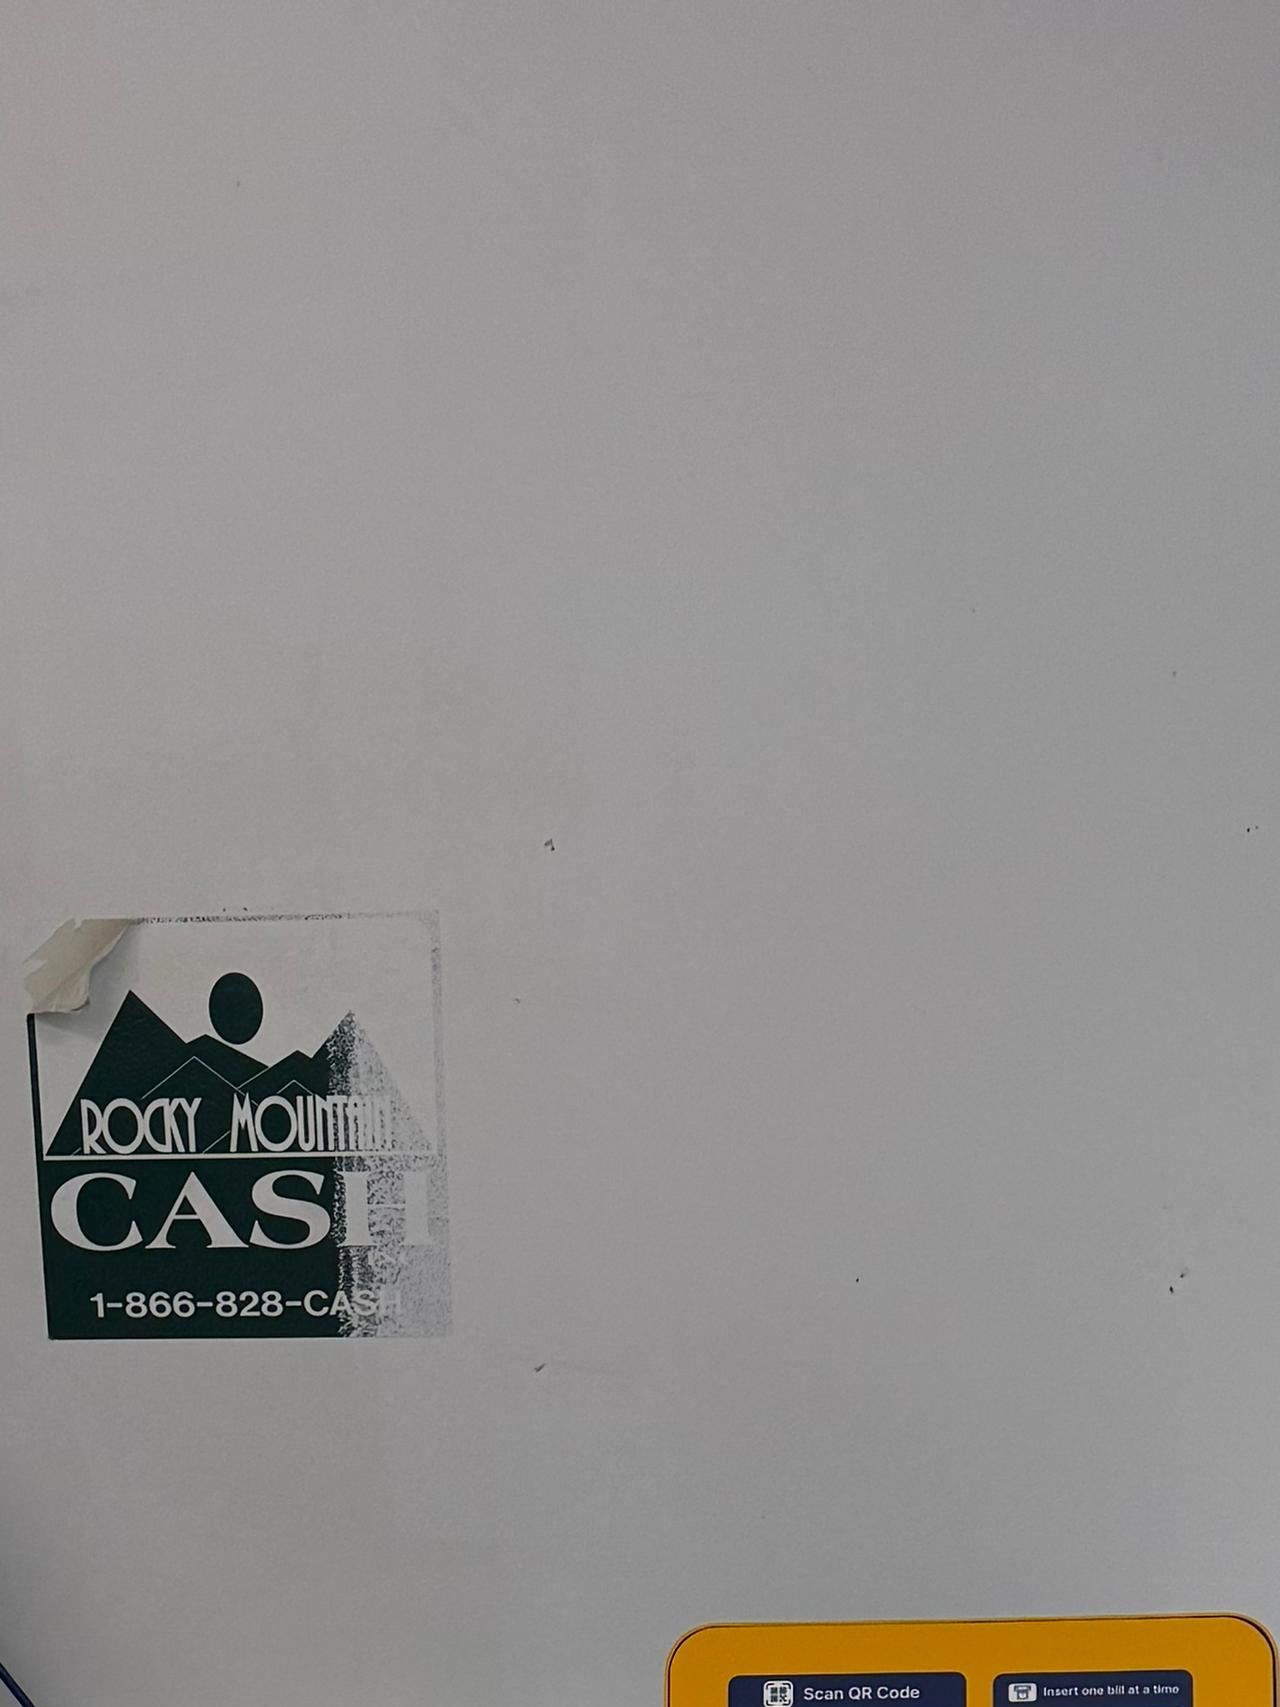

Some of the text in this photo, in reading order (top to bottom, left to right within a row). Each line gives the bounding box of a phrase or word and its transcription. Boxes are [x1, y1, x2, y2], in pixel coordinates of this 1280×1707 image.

[80, 1097, 202, 1155] ROCKY
[803, 1685, 920, 1702] Scan QR Code
[1043, 1684, 1180, 1697] Insert one bill at time
